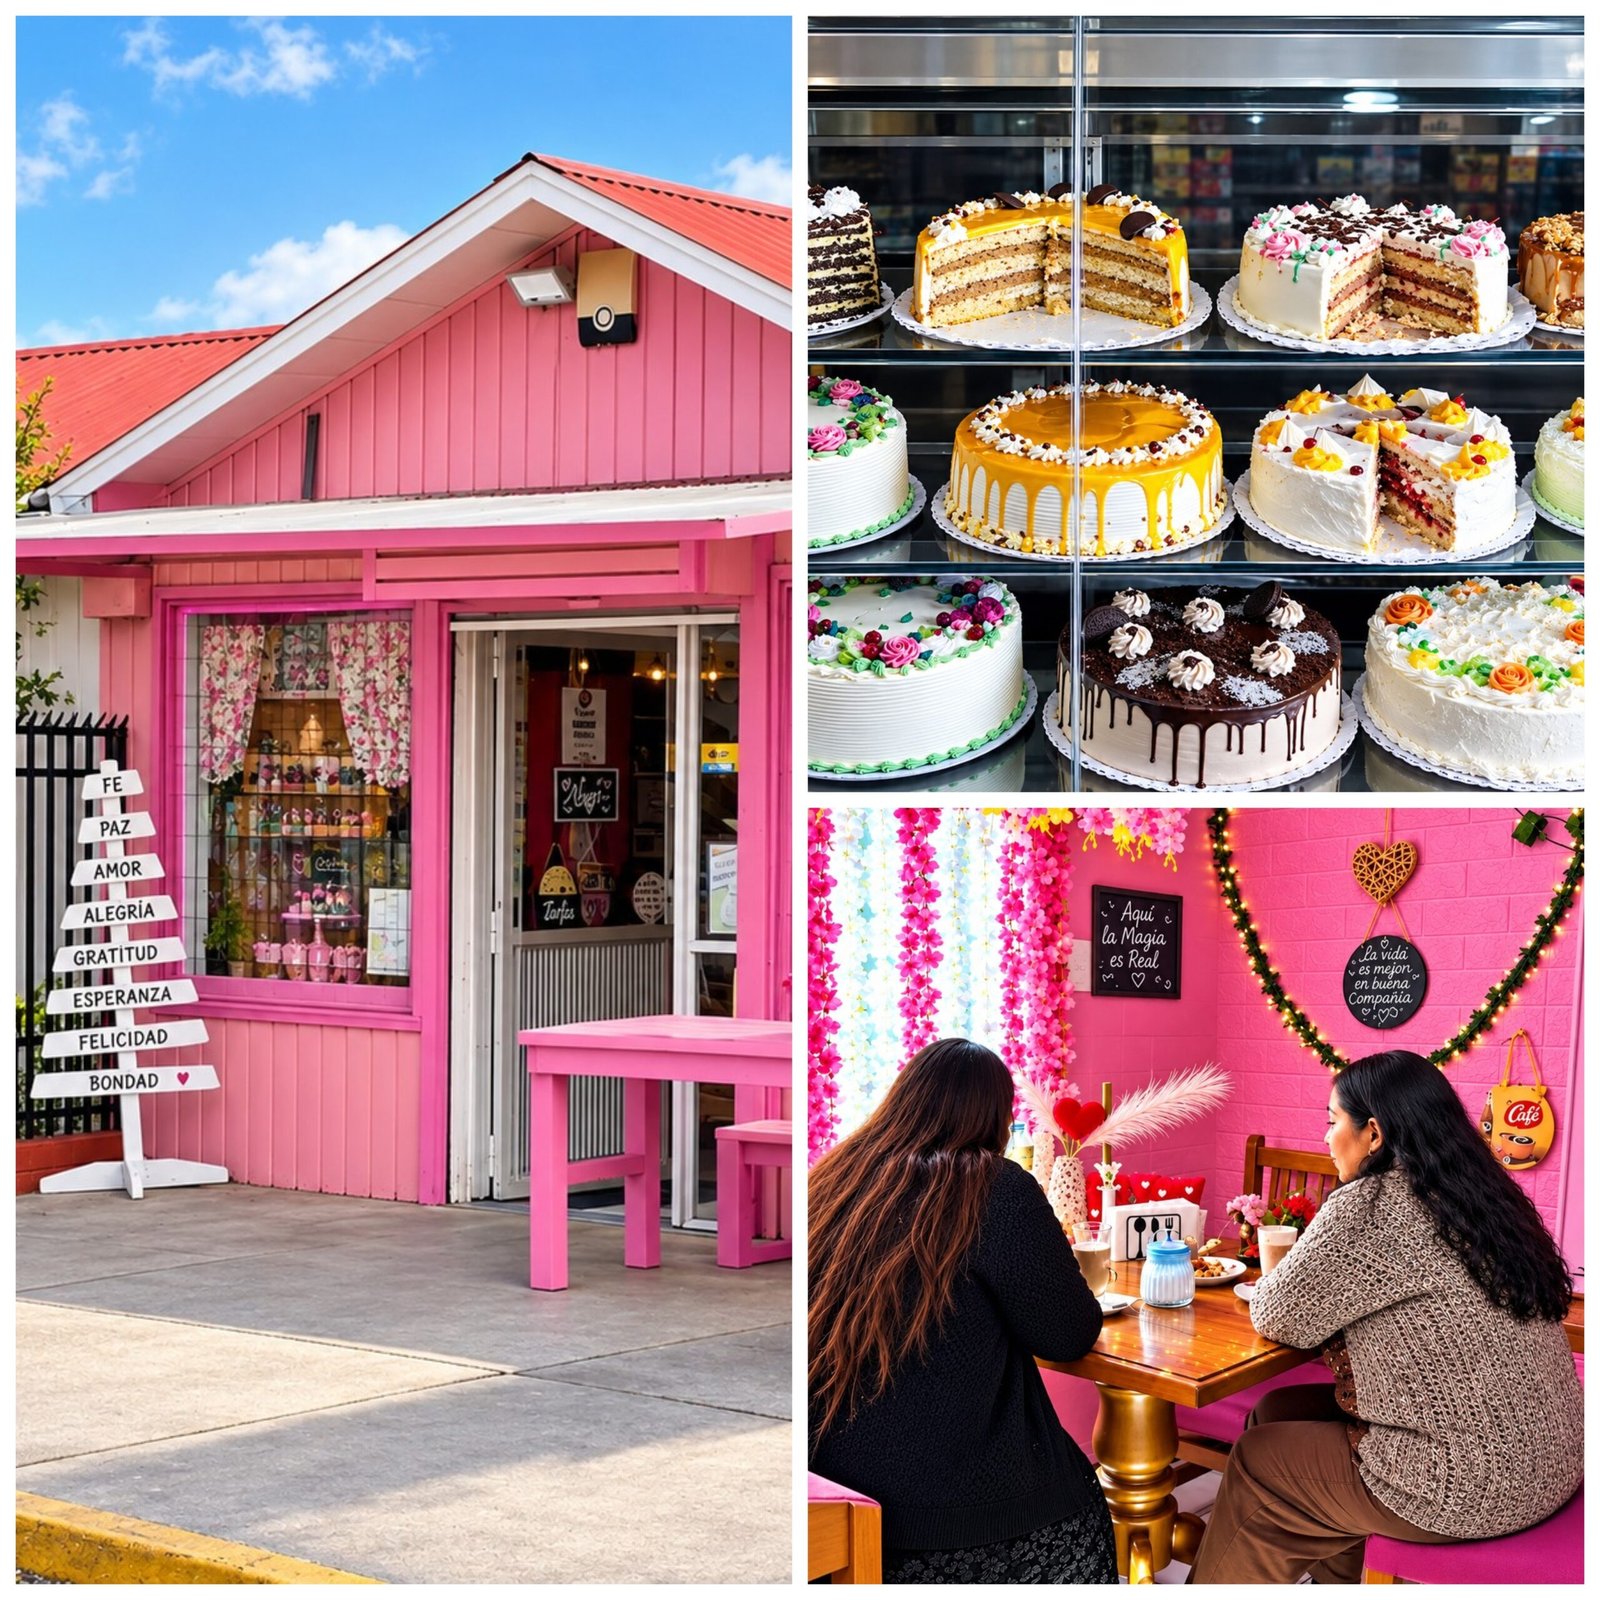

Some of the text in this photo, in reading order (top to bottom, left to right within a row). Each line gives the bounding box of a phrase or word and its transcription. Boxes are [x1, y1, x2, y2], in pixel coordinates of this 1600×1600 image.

[103, 776, 123, 793] FE
[100, 819, 131, 837] PAZ
[93, 860, 142, 880] AMOR
[1120, 900, 1154, 928] Aquí
[1102, 925, 1167, 952] la Magia
[74, 945, 158, 966] GRATITUD
[1110, 949, 1159, 969] es Real
[1358, 965, 1371, 975] es
[1354, 976, 1411, 990] en buena
[73, 986, 172, 1008] ESPERANZA
[79, 1028, 168, 1051] FELICIDAD
[89, 1073, 158, 1091] BONDAD
[1508, 1103, 1540, 1126] Café
